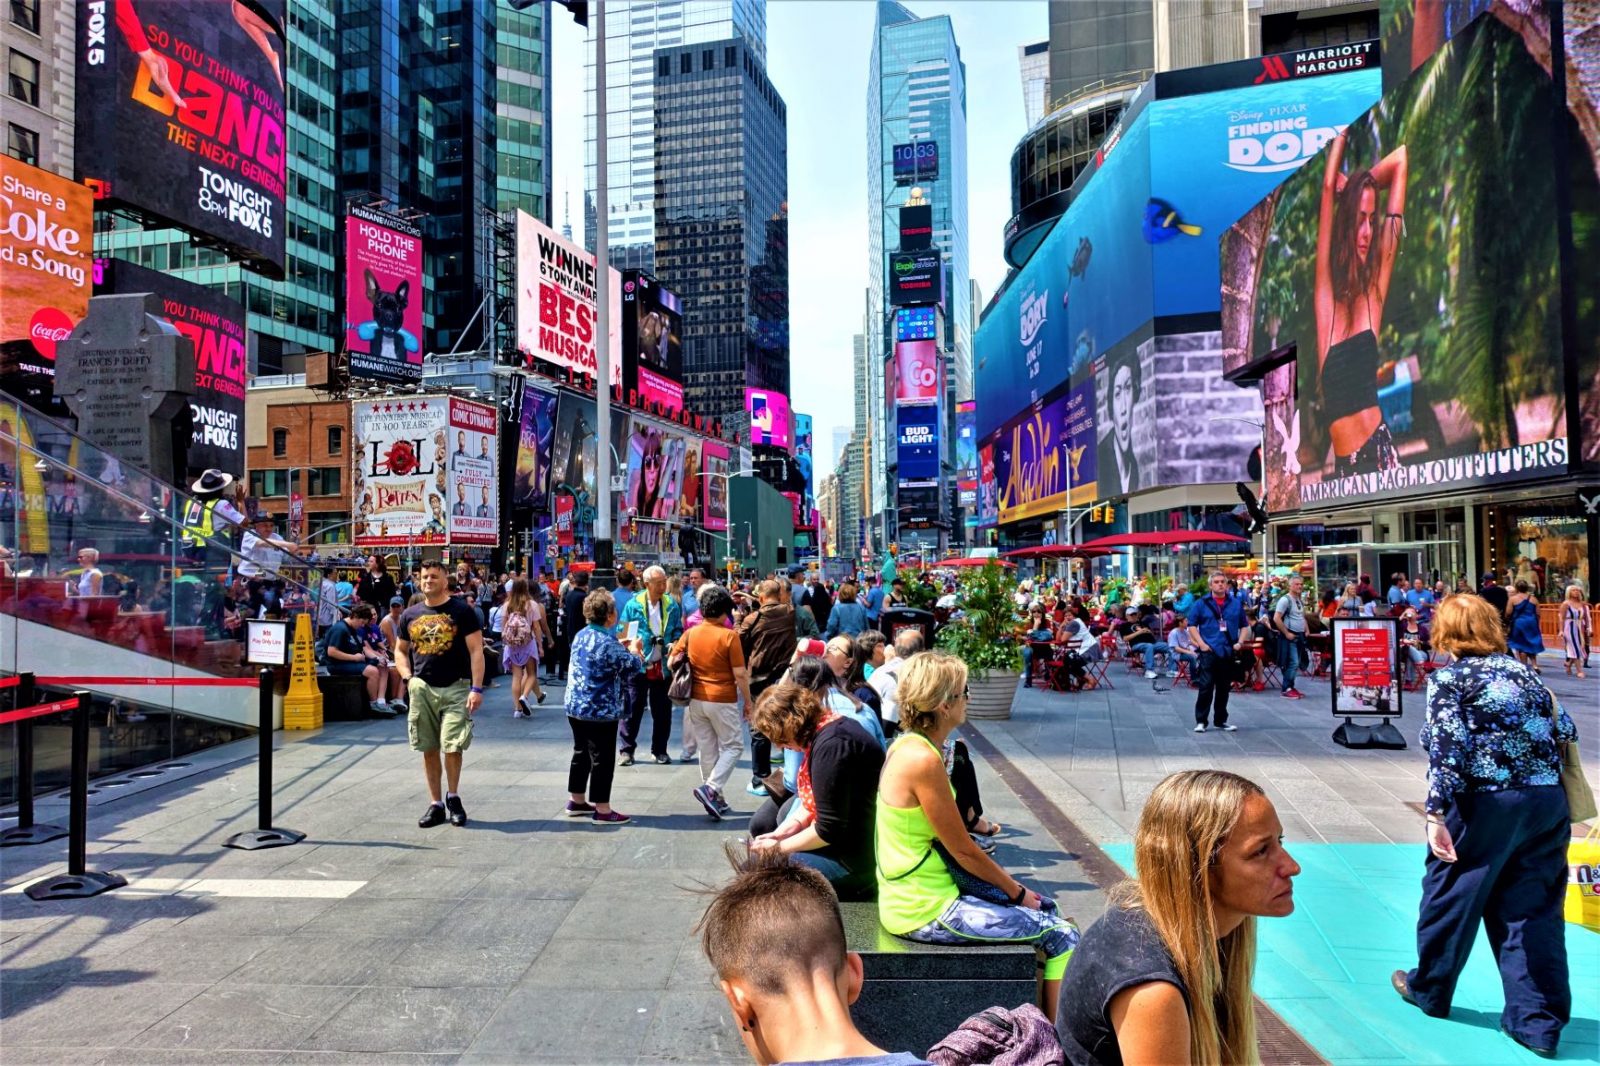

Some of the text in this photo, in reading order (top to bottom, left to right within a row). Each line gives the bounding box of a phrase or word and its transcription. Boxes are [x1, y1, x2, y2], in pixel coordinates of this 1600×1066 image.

[88, 0, 106, 66] FOX 5
[1296, 43, 1373, 63] MARRIOTT
[1296, 56, 1364, 75] MARQUIS
[147, 24, 170, 49] SO
[174, 37, 204, 68] YOU
[207, 57, 251, 96] THINK
[252, 83, 273, 112] YOU
[1227, 103, 1308, 123] Disney PIXAR
[1228, 116, 1308, 139] FINDING
[167, 122, 198, 152] THE
[199, 139, 239, 170] NEXT
[3, 174, 66, 212] Share a
[198, 165, 273, 217] TONIGHT
[198, 187, 273, 239] 8PM FOX 5
[351, 206, 421, 237] HUMANEWATCH.ORG
[359, 223, 415, 252] HOLD THE
[368, 238, 408, 261] PHONE
[17, 253, 28, 267] a
[31, 248, 85, 287] Song
[540, 260, 547, 275] 6
[547, 264, 574, 289] TONY
[624, 293, 635, 301] LG
[163, 299, 187, 318] YOU
[189, 307, 220, 328] THINK
[222, 317, 236, 335] YOU
[1020, 289, 1049, 340] DORY
[78, 357, 113, 368] FRANCIS
[122, 355, 152, 367] DUFFY
[538, 325, 598, 371] MUSICA
[19, 362, 56, 376] TASTE THE
[190, 403, 238, 432] ONIGHT
[371, 422, 381, 432] IN
[383, 421, 399, 432] 400
[905, 426, 930, 436] BUD
[204, 424, 238, 451] FOX 5
[521, 430, 537, 449] BFG
[901, 434, 934, 444] LIGHT
[456, 476, 492, 487] COMMITTED
[464, 468, 483, 477] FULLY
[1300, 438, 1567, 503] AMERICAN EAGLE OUTFITTERS
